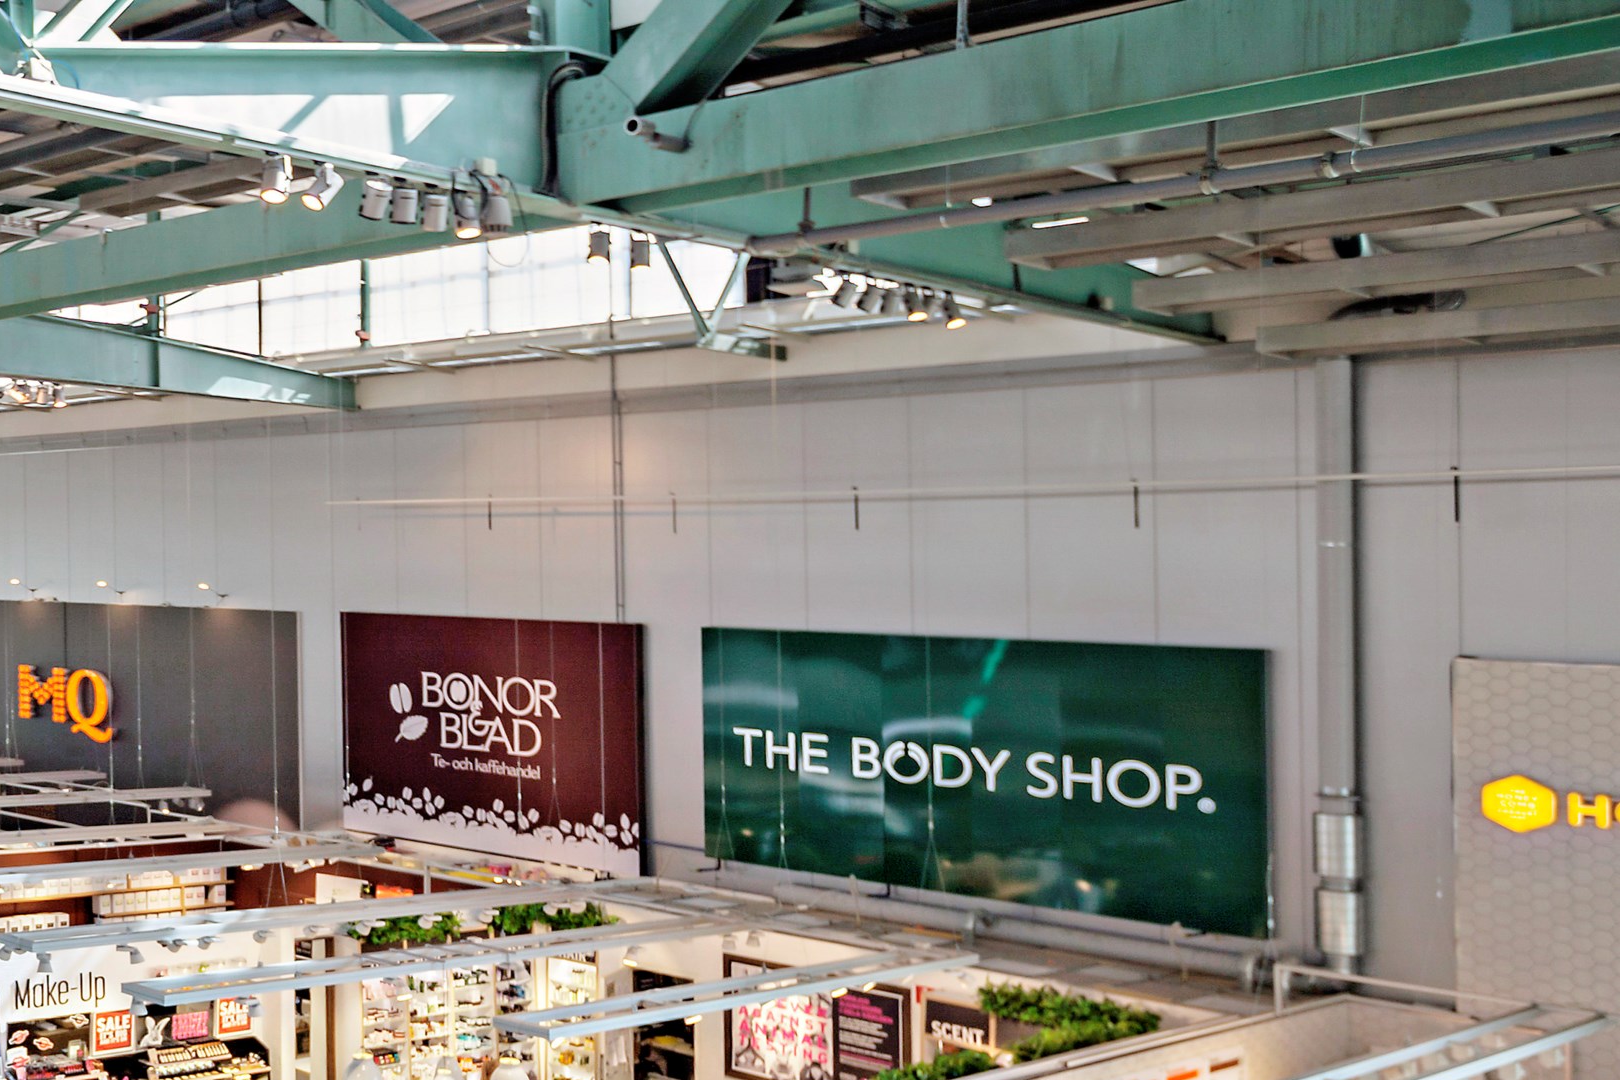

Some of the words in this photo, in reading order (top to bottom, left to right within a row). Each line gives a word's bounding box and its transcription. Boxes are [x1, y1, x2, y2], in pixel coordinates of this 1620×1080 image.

[17, 664, 115, 743] MQ
[421, 671, 562, 719] BONOR
[440, 712, 542, 758] BLAD
[430, 752, 451, 768] Te-
[452, 756, 473, 771] och
[474, 757, 541, 780] kaffehandel
[732, 726, 830, 775] THE
[850, 735, 1012, 792] BODY
[1567, 791, 1620, 829] H
[14, 970, 107, 1010] Make-Up
[96, 1013, 131, 1033] SALE
[738, 1006, 828, 1033] AGAINST
[738, 1021, 829, 1051] ANIMAL
[931, 1019, 985, 1047] SCENT
[740, 1033, 829, 1065] TESTING
